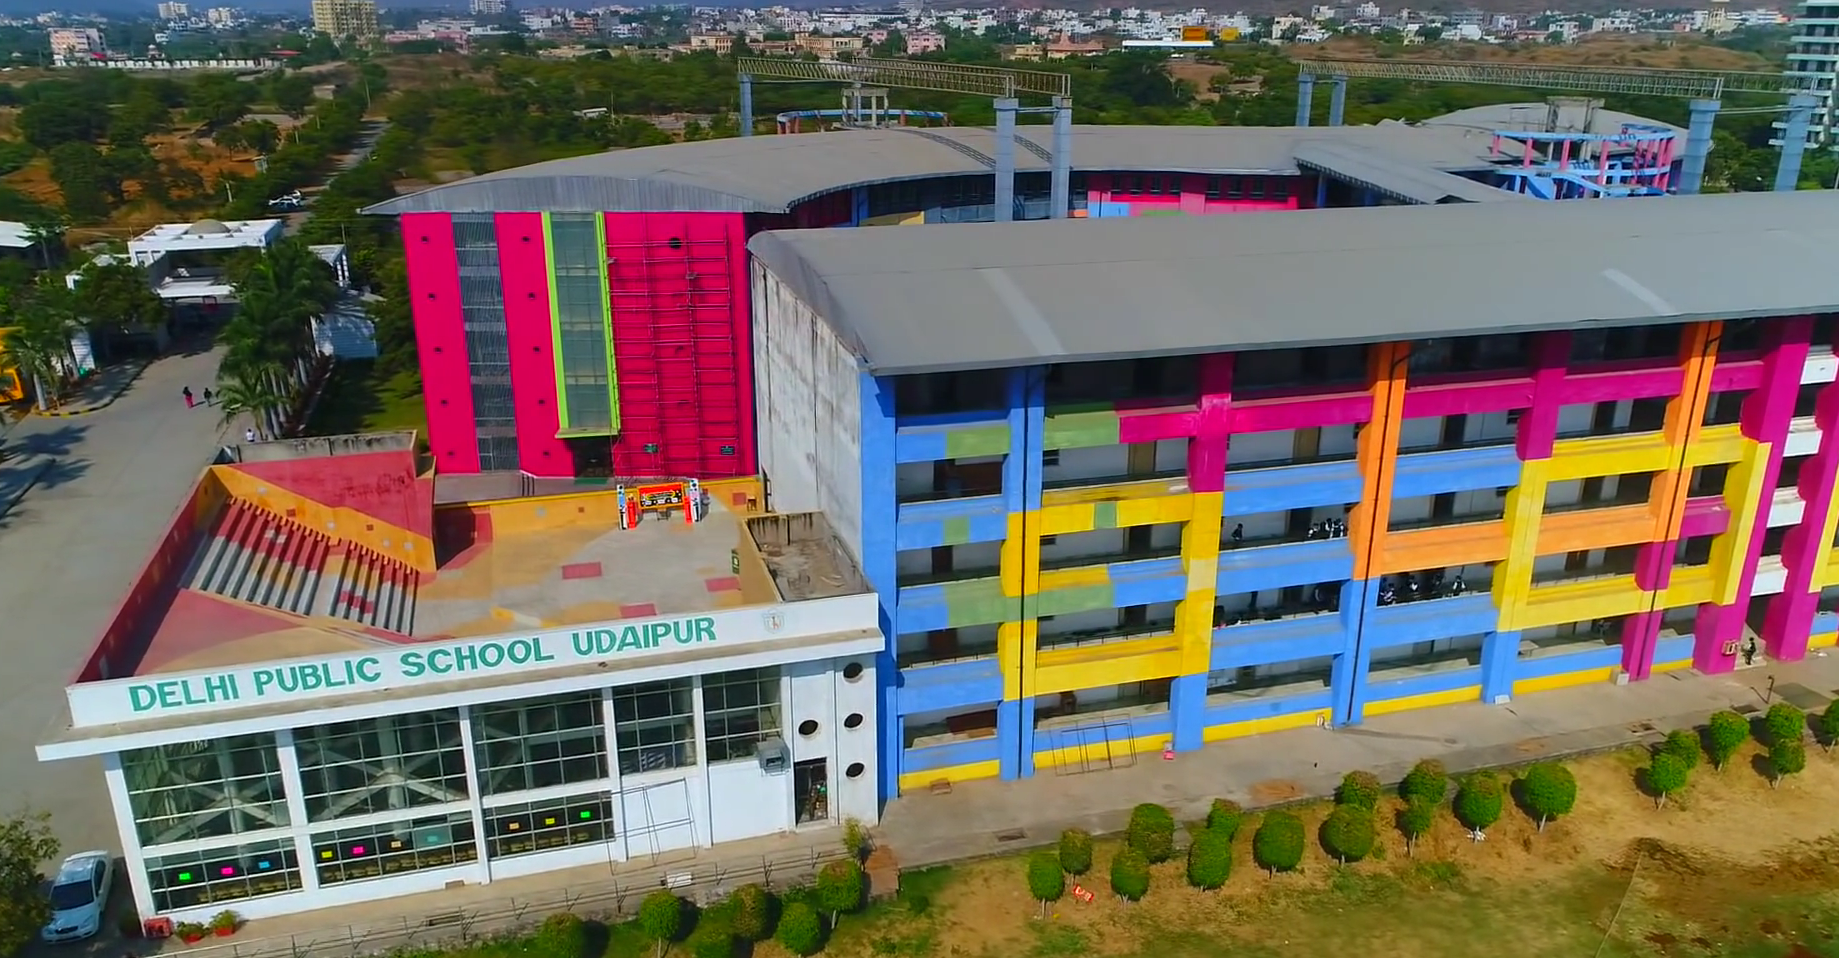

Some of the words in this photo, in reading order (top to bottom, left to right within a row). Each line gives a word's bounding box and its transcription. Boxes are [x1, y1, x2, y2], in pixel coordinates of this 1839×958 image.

[128, 674, 240, 711] DELHI
[254, 657, 381, 696] PUBLIC
[400, 639, 555, 678] SCHOOL
[573, 618, 716, 656] UDAIPUR
